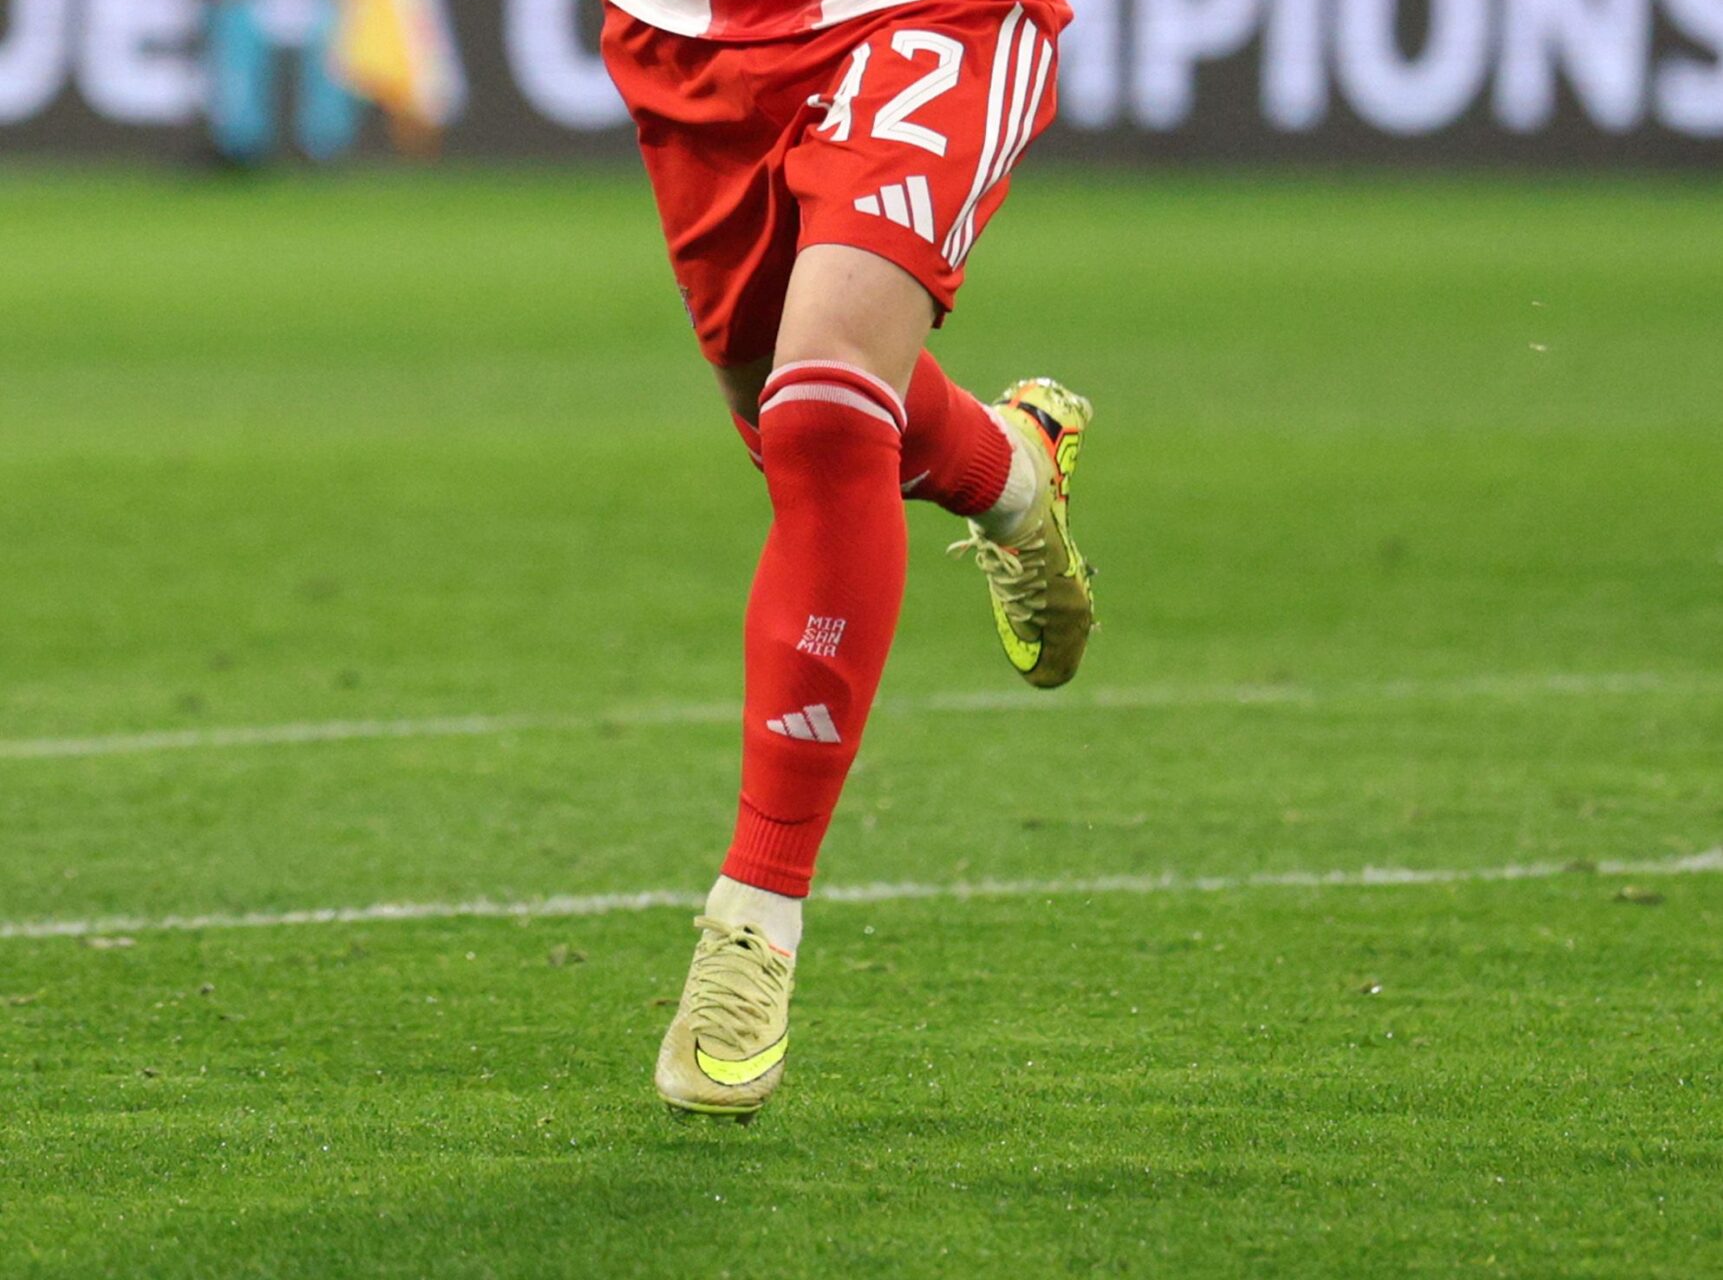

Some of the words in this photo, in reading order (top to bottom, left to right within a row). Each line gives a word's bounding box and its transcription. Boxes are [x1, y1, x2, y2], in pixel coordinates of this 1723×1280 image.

[807, 615, 846, 631] MIA
[802, 628, 843, 645] SAN
[796, 639, 837, 657] MIA
